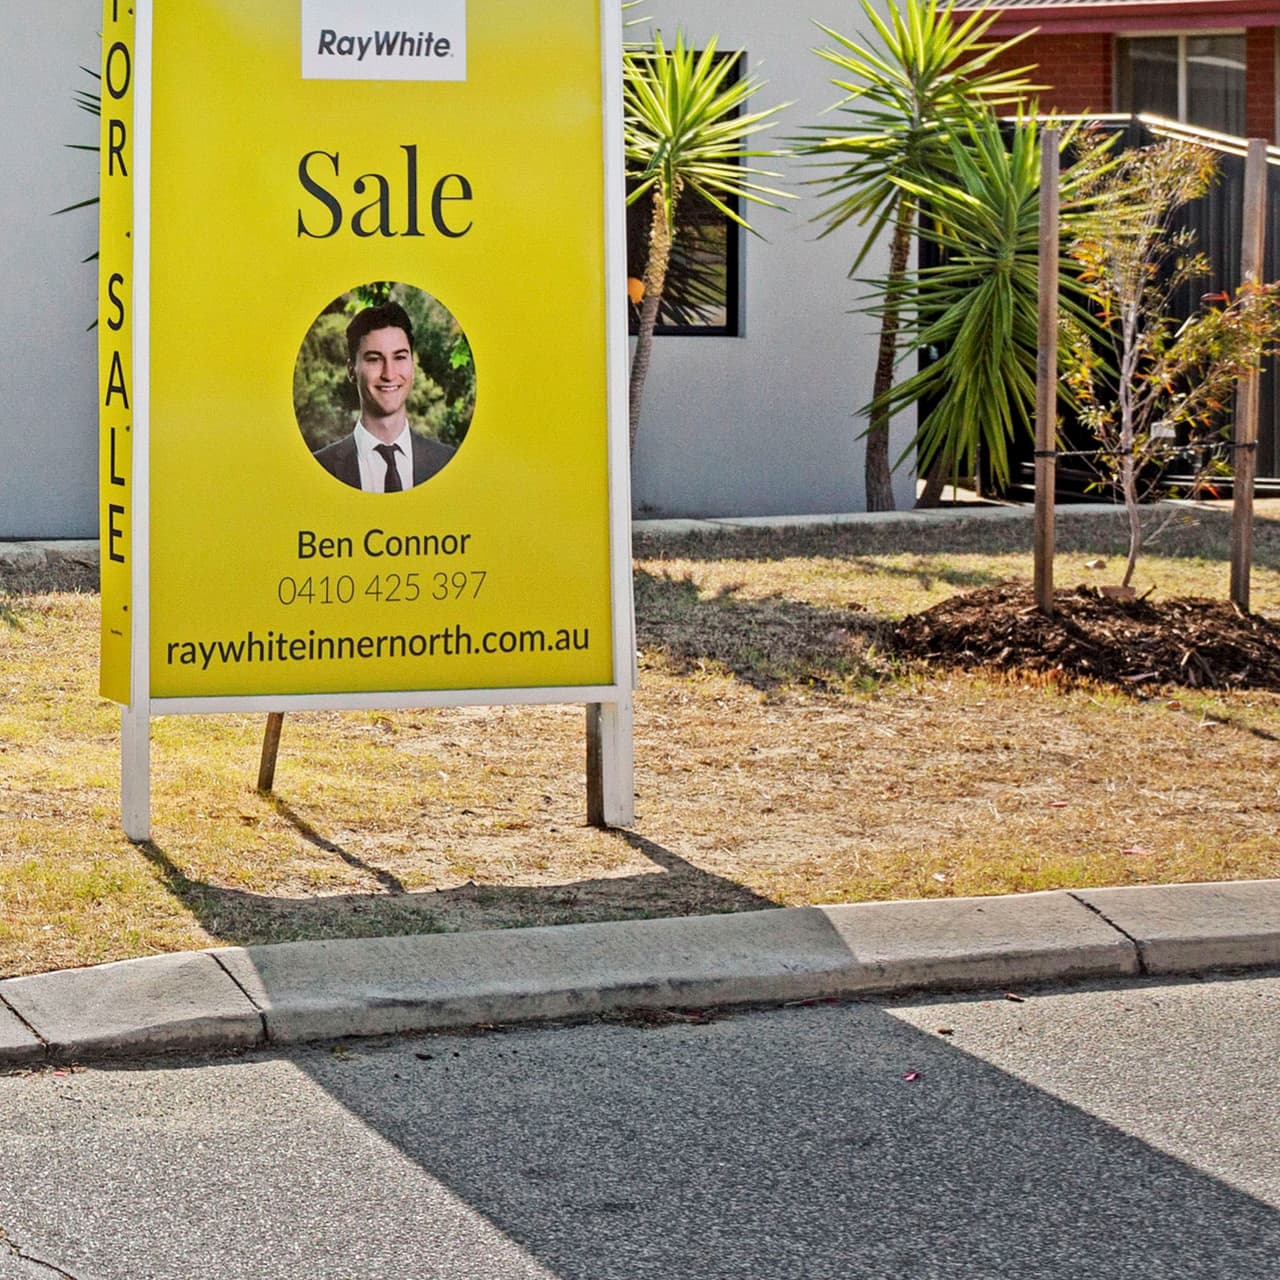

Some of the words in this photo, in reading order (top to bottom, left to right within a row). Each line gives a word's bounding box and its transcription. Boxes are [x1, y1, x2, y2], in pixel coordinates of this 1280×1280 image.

[318, 30, 450, 61] RayWhite
[297, 144, 473, 239] Sale
[105, 273, 130, 563] SALE
[298, 531, 352, 559] Ben
[364, 529, 471, 557] Connor
[278, 575, 354, 605] 0410
[365, 573, 420, 602] 425
[432, 571, 487, 600] 397
[167, 624, 589, 670] raywhiteinnernorth.com.au
